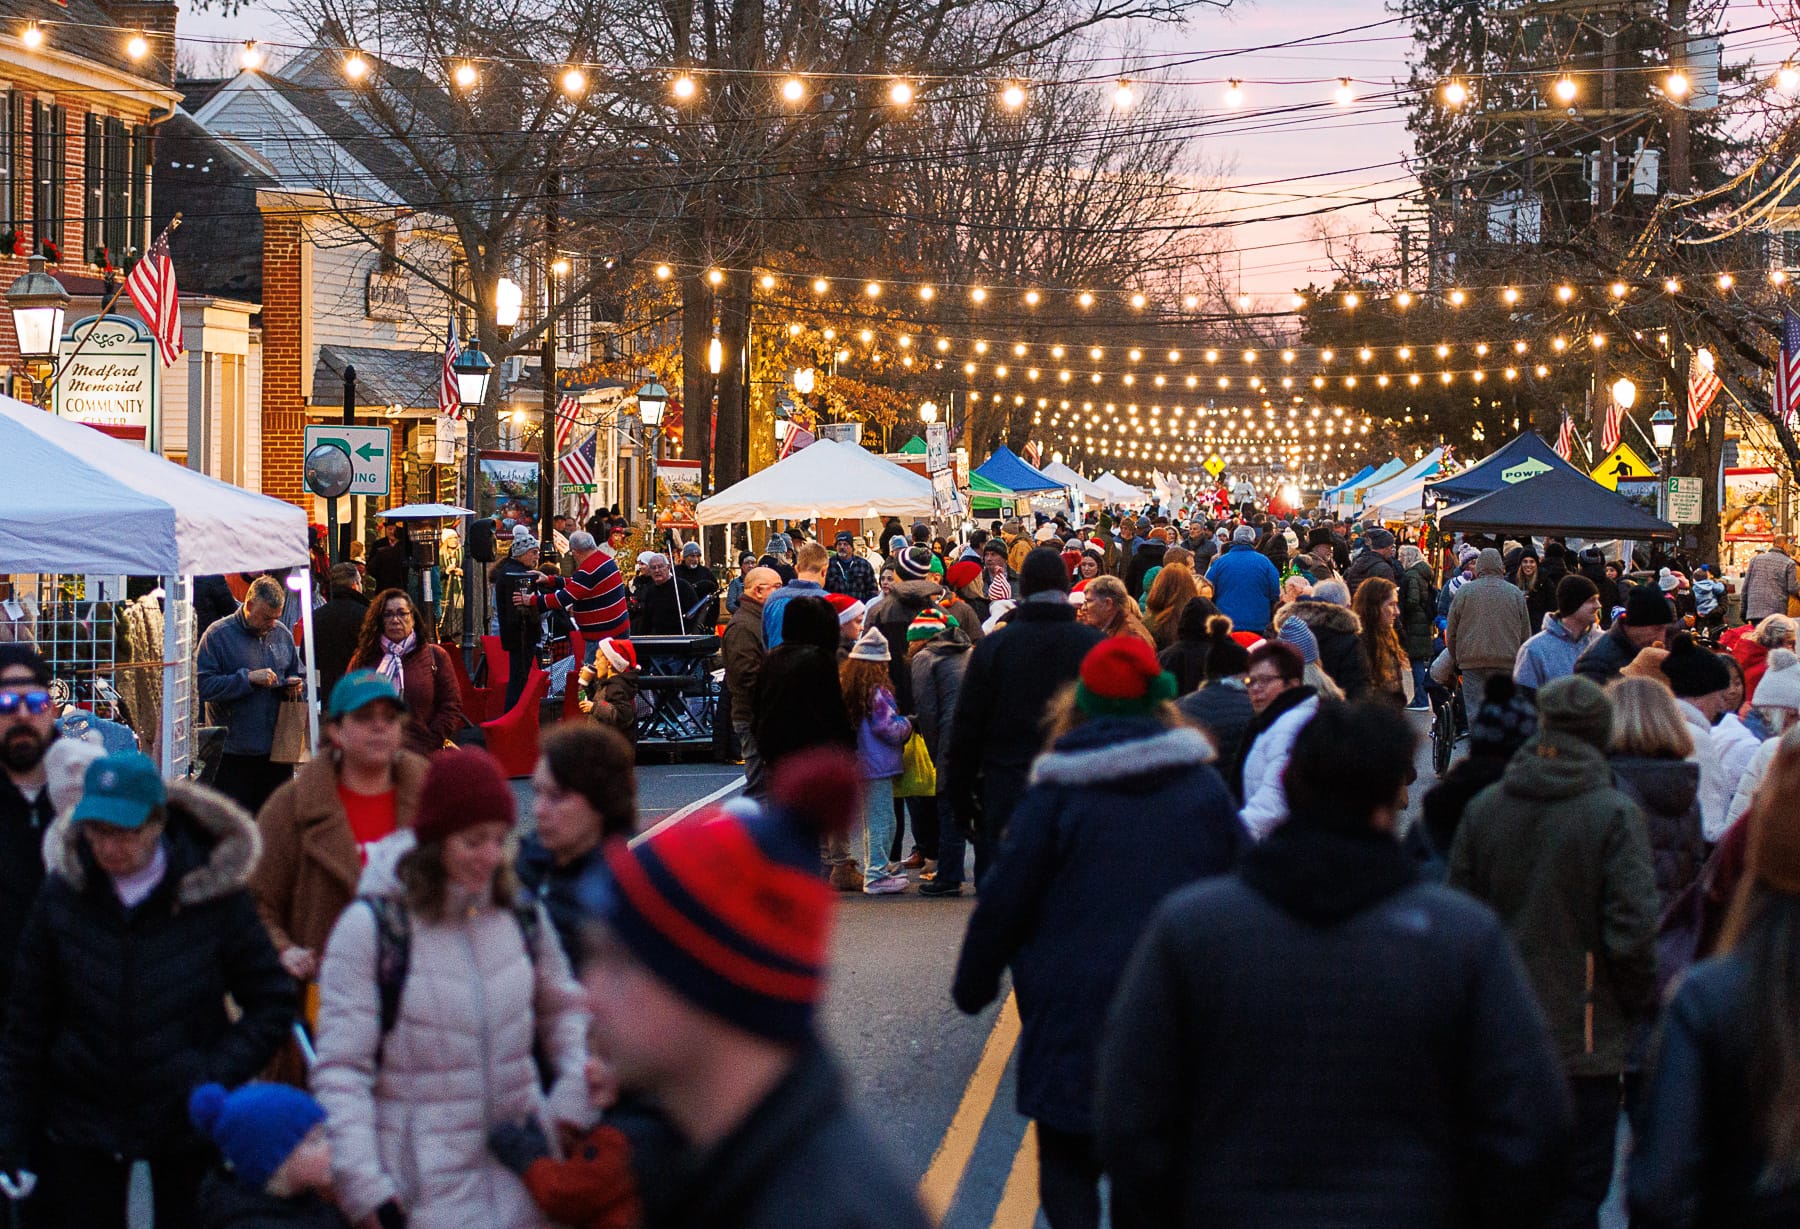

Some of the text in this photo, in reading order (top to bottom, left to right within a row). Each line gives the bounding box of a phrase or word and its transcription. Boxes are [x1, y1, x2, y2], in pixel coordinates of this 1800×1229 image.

[72, 363, 139, 381] Medford
[68, 378, 143, 392] Memorial
[65, 398, 144, 413] COMMUNITY
[1671, 480, 1678, 490] 2
